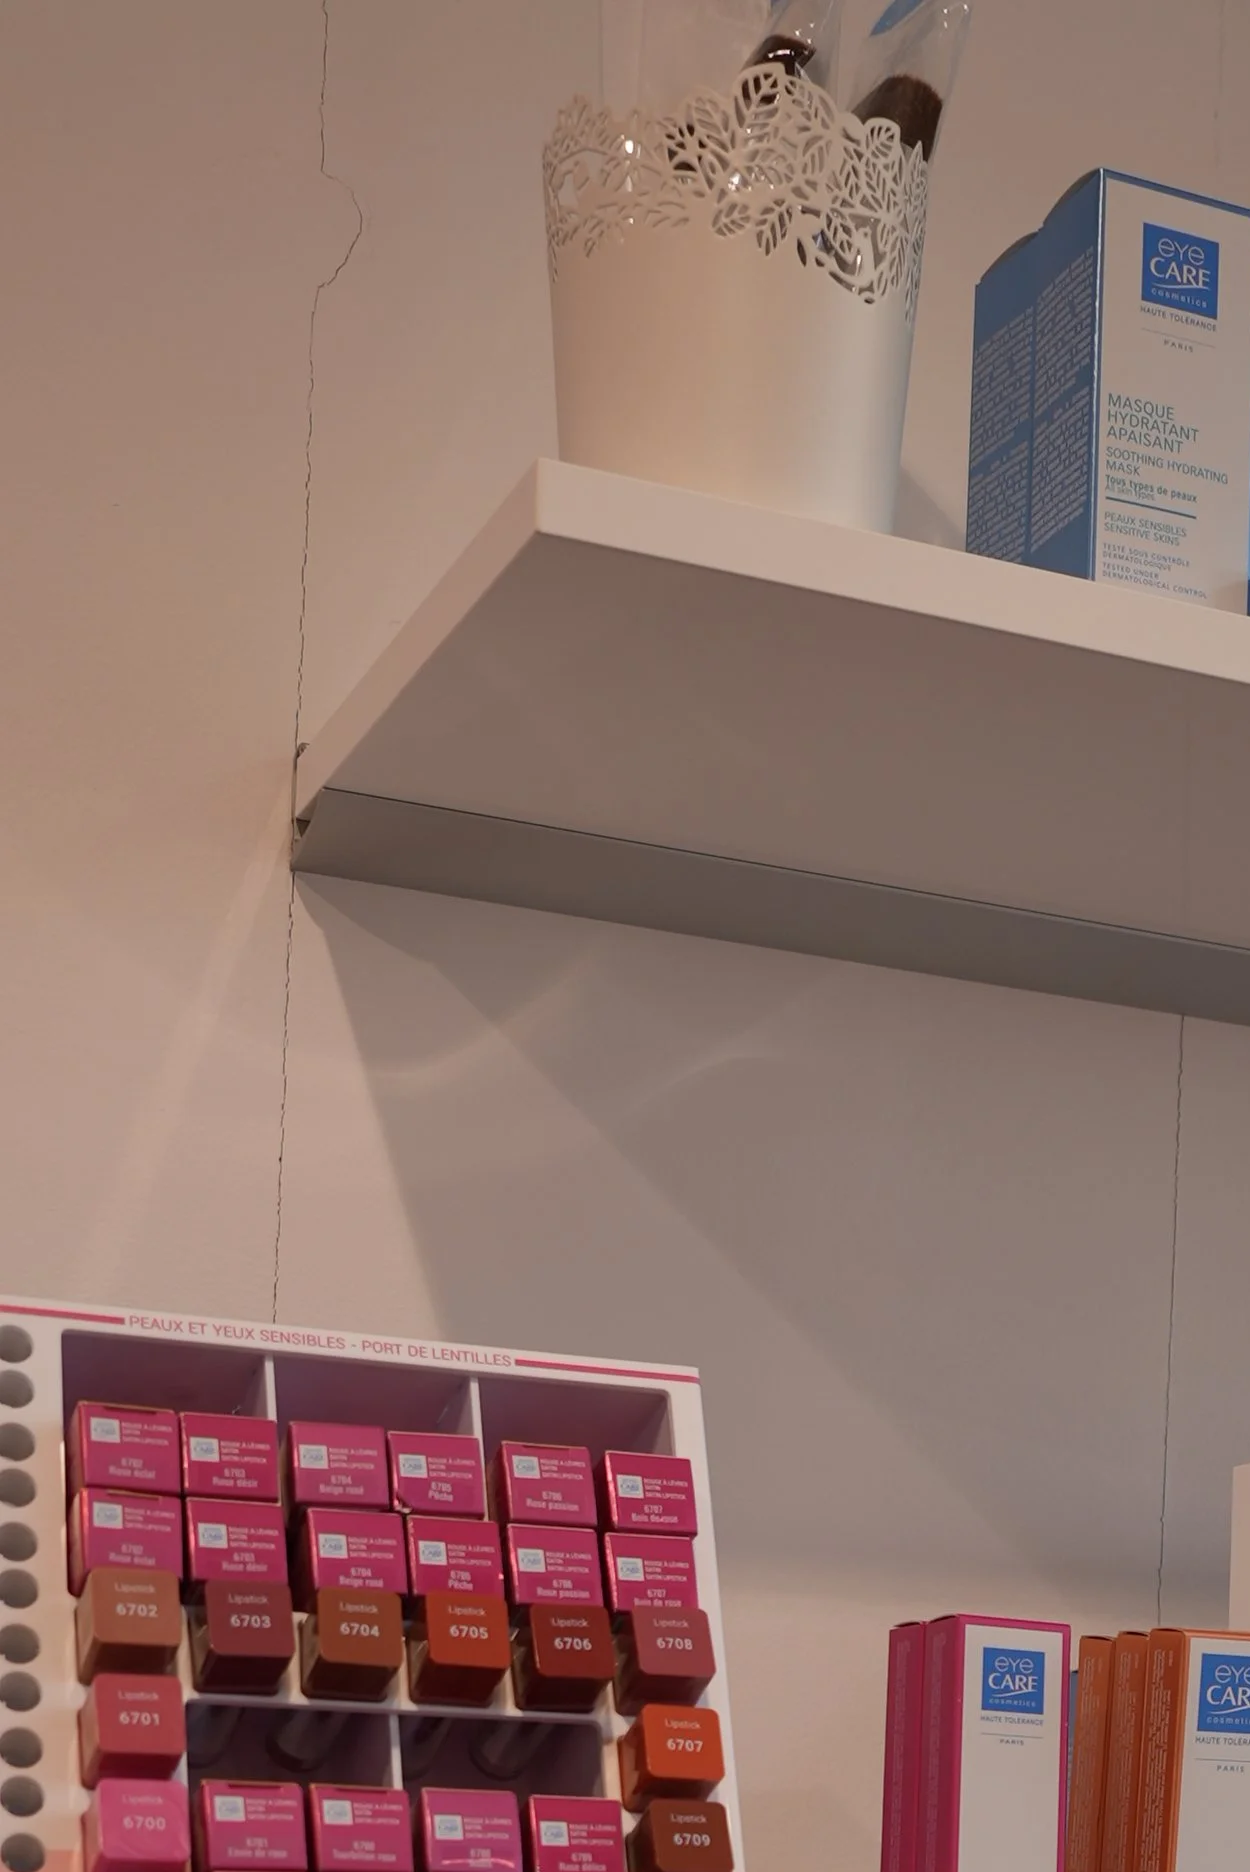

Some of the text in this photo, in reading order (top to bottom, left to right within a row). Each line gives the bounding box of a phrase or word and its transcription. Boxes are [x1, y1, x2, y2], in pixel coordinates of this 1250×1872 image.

[1158, 238, 1204, 265] eye
[1150, 257, 1211, 288] CARE
[1108, 393, 1175, 421] MASQUE
[1107, 409, 1199, 442] HYDRATANT
[1106, 425, 1183, 454] APAISANT
[1105, 460, 1141, 477] MASK
[1106, 446, 1228, 485] SOOTHING HYDRATING
[129, 1315, 511, 1367] PEAUX ET YEUX SENSIBLES PORT DE LENTILLES
[115, 1602, 158, 1618] 6702
[230, 1614, 271, 1629] 6703
[340, 1622, 380, 1637] 6704
[450, 1625, 488, 1640] 6705
[554, 1637, 593, 1651] 6706
[656, 1637, 693, 1650] 6708
[995, 1657, 1034, 1674] eye
[988, 1673, 1038, 1690] CARE
[119, 1711, 160, 1726] 6701
[667, 1738, 704, 1752] 6707
[123, 1816, 167, 1831] 6700
[673, 1833, 711, 1847] 6709
